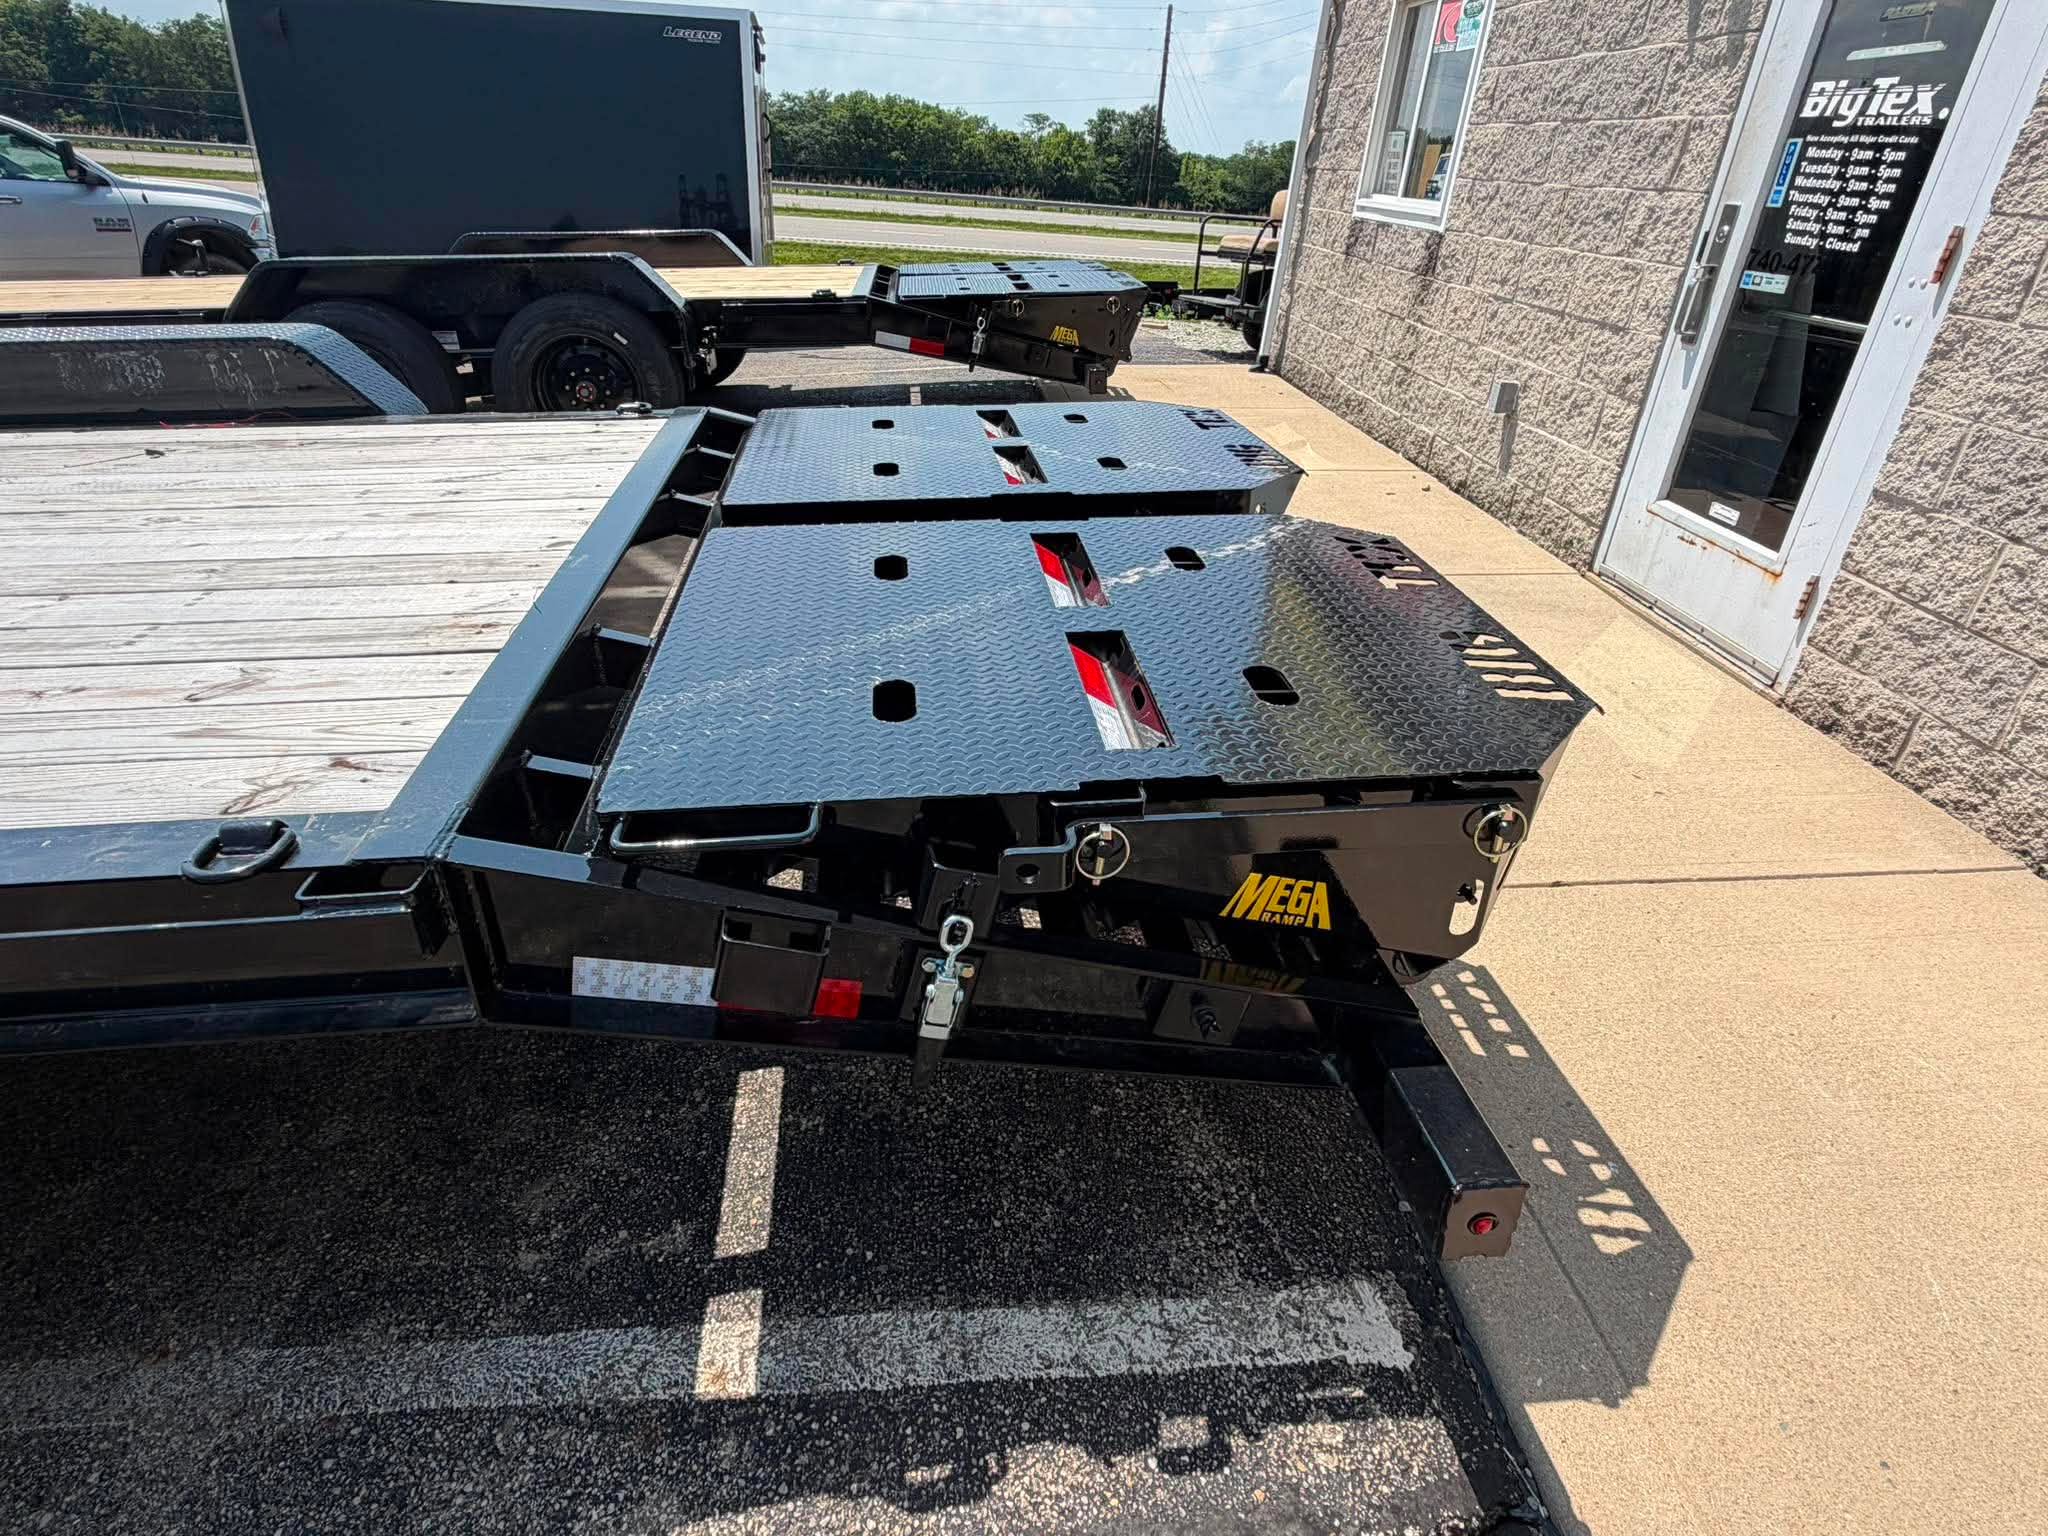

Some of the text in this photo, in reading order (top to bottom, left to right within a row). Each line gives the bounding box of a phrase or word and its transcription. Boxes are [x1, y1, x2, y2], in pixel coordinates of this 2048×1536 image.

[663, 26, 722, 40] LEGEND
[1857, 115, 1933, 126] TRAILERS
[1806, 146, 1844, 161] Monday
[1850, 148, 1875, 161] 9am
[1881, 148, 1906, 163] 5pm
[1800, 162, 1840, 176] Tuesday
[1845, 165, 1870, 178] 9am
[1877, 165, 1902, 179] 5pm
[1794, 176, 1842, 191] Wednesday
[1846, 179, 1868, 192] 9am
[1874, 180, 1897, 195] 5pm
[1788, 190, 1831, 206] Thursday
[1837, 195, 1860, 207] 9am
[1867, 196, 1890, 211] 5pm
[1789, 205, 1819, 219] Friday
[1824, 208, 1847, 221] 9am
[1854, 210, 1878, 224] 5pm
[1786, 218, 1821, 234] Saturday
[1826, 223, 1845, 234] 9am
[1784, 233, 1819, 248] Sunday
[1825, 238, 1861, 252] Closed
[1050, 326, 1080, 346] MEGA
[1219, 872, 1332, 931] MEGA
[1261, 911, 1305, 927] RAMP
